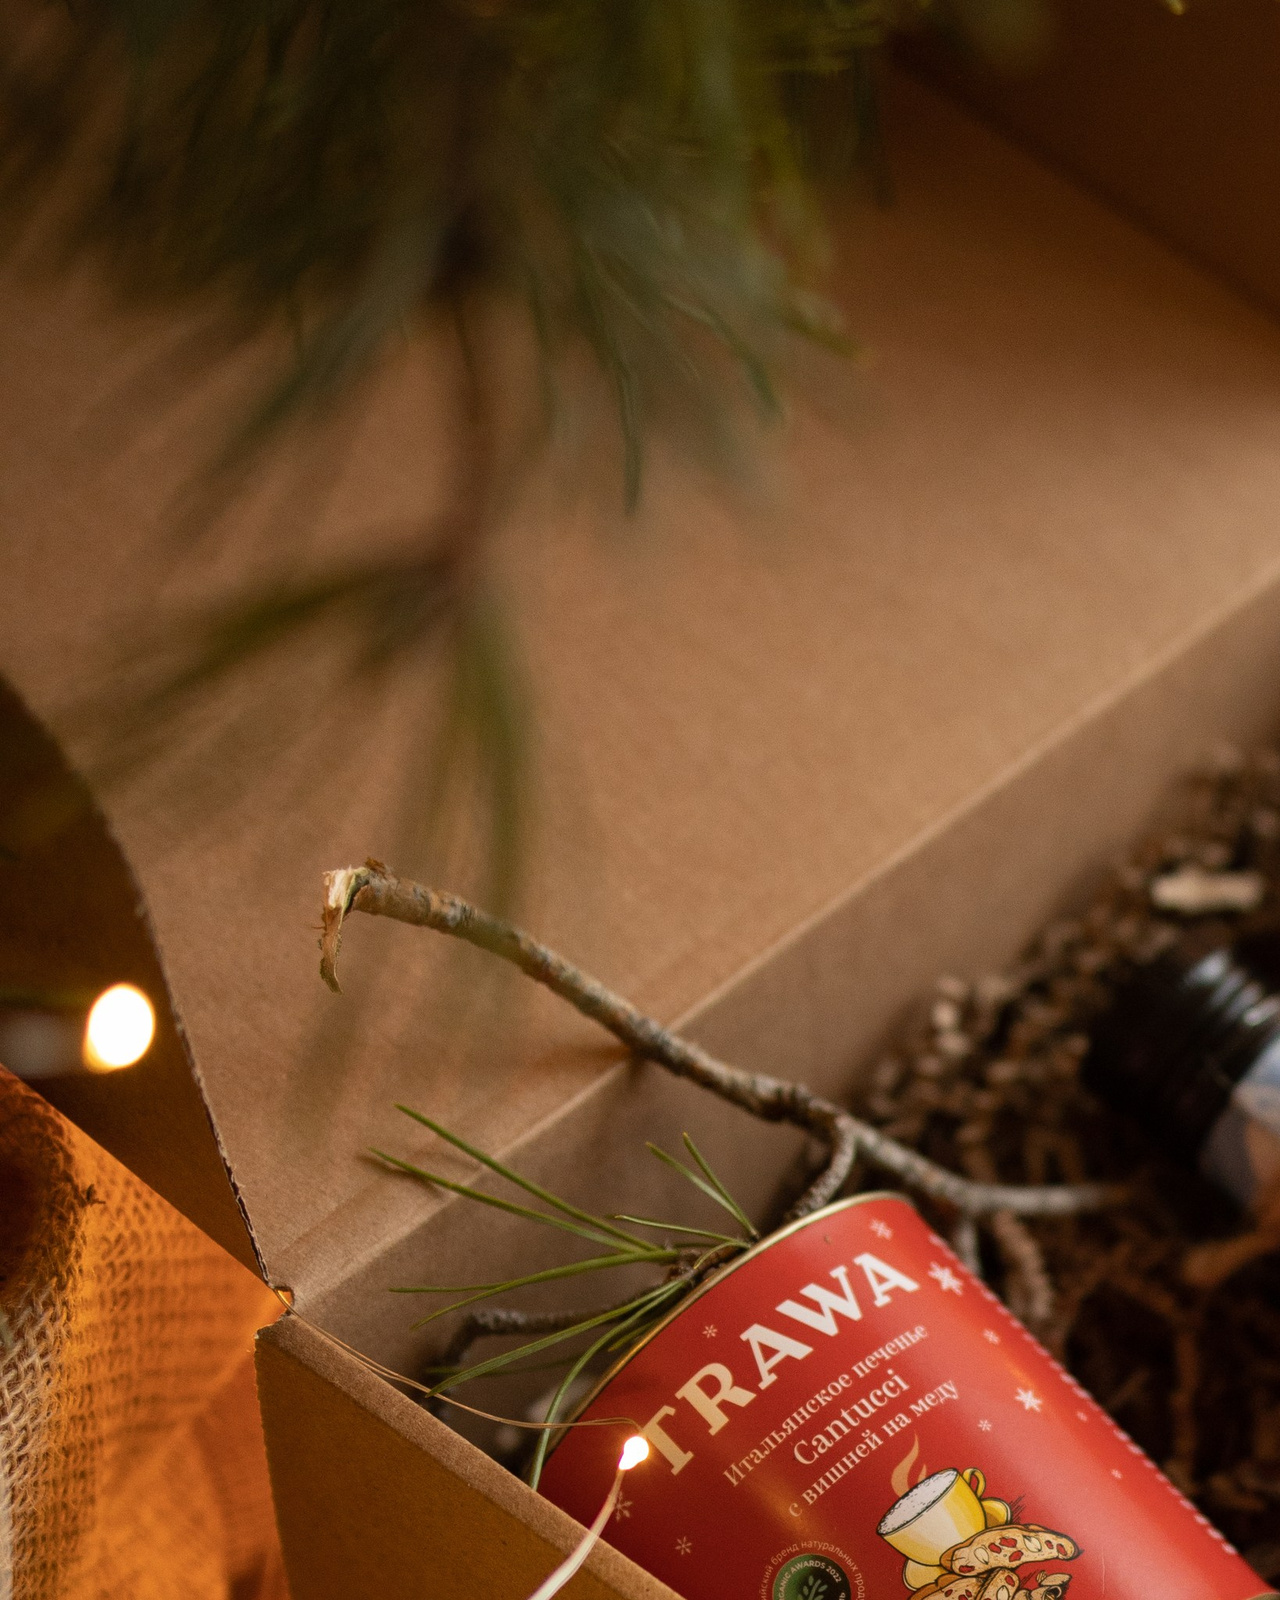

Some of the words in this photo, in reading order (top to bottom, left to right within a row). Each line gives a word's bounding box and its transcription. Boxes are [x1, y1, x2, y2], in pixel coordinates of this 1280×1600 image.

[643, 1252, 920, 1476] TRAWA
[722, 1372, 853, 1487] Итальянское
[851, 1325, 928, 1378] печенье
[793, 1369, 910, 1465] Cantucci
[788, 1503, 802, 1517] с
[802, 1430, 883, 1505] вишней
[881, 1412, 912, 1438] на
[909, 1380, 959, 1417] меду
[770, 1543, 799, 1565] бренд
[801, 1541, 858, 1572] натуральных
[790, 1560, 826, 1573] AWARDS
[826, 1566, 842, 1583] 2022
